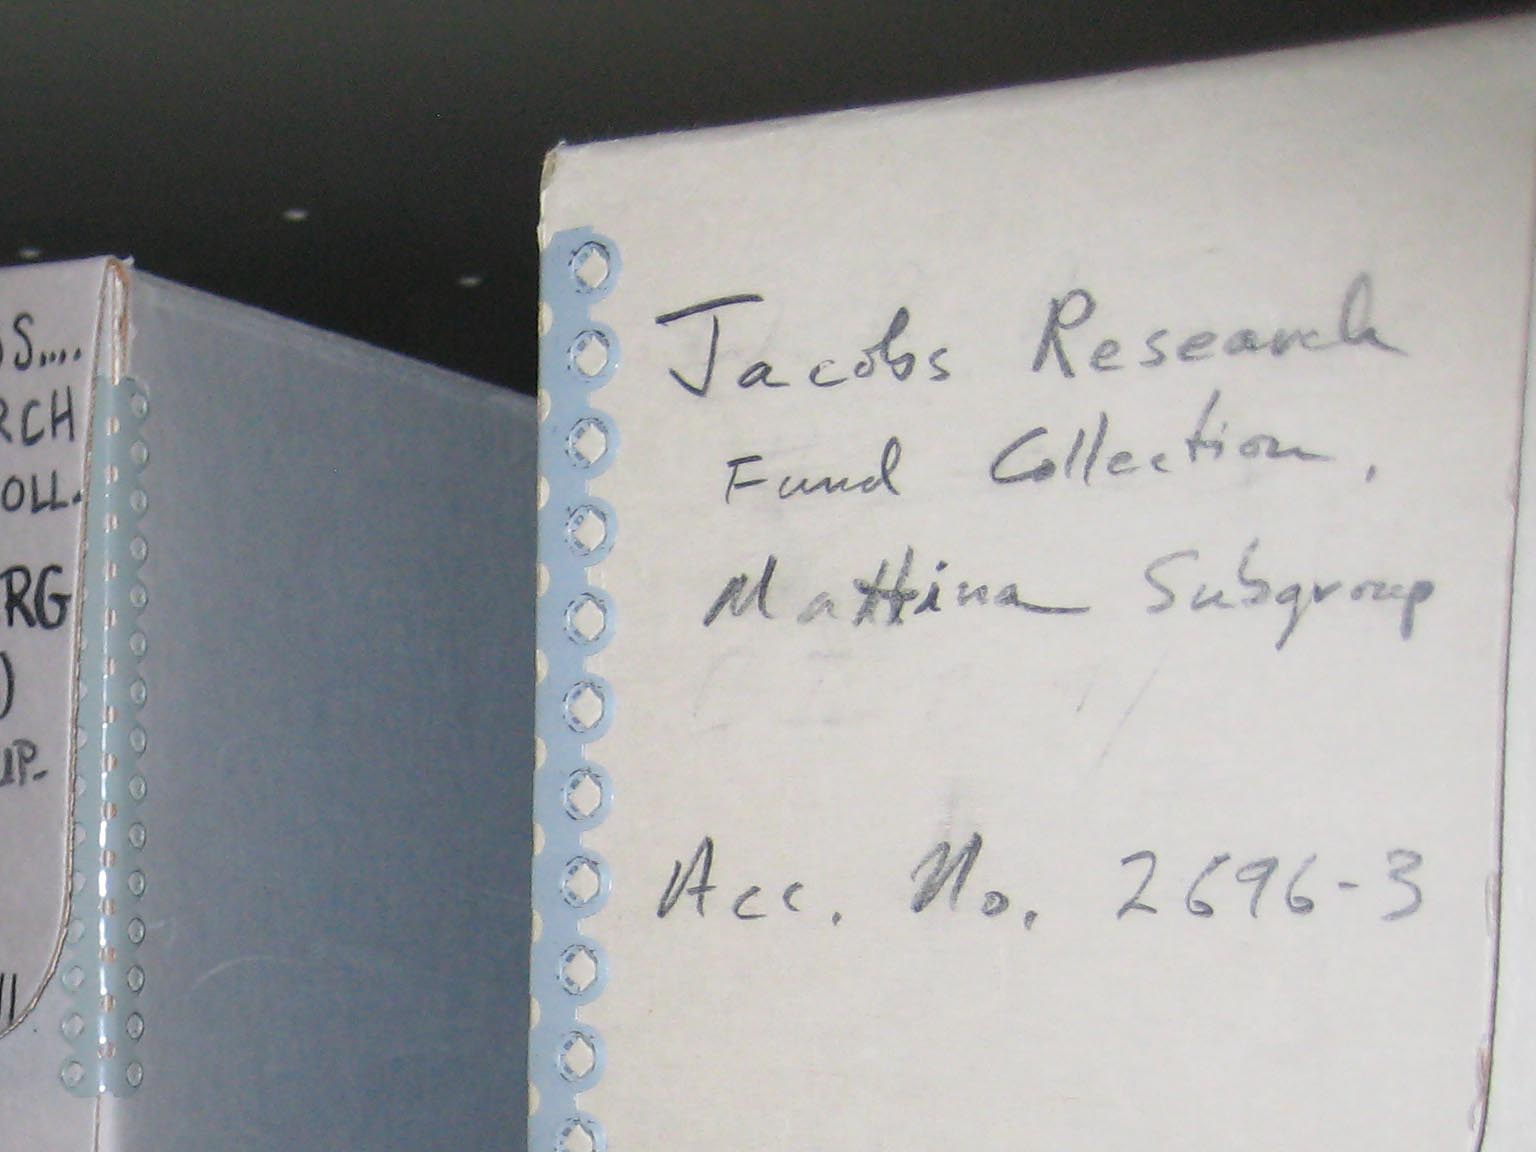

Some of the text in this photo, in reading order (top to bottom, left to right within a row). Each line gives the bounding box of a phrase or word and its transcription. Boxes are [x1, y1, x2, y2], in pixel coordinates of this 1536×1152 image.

[654, 272, 1407, 398] Jacobs Research
[722, 435, 902, 501] Fund
[702, 538, 1438, 650] Mattina Subgroup
[655, 830, 1426, 932] Acc. No. 2696-3
